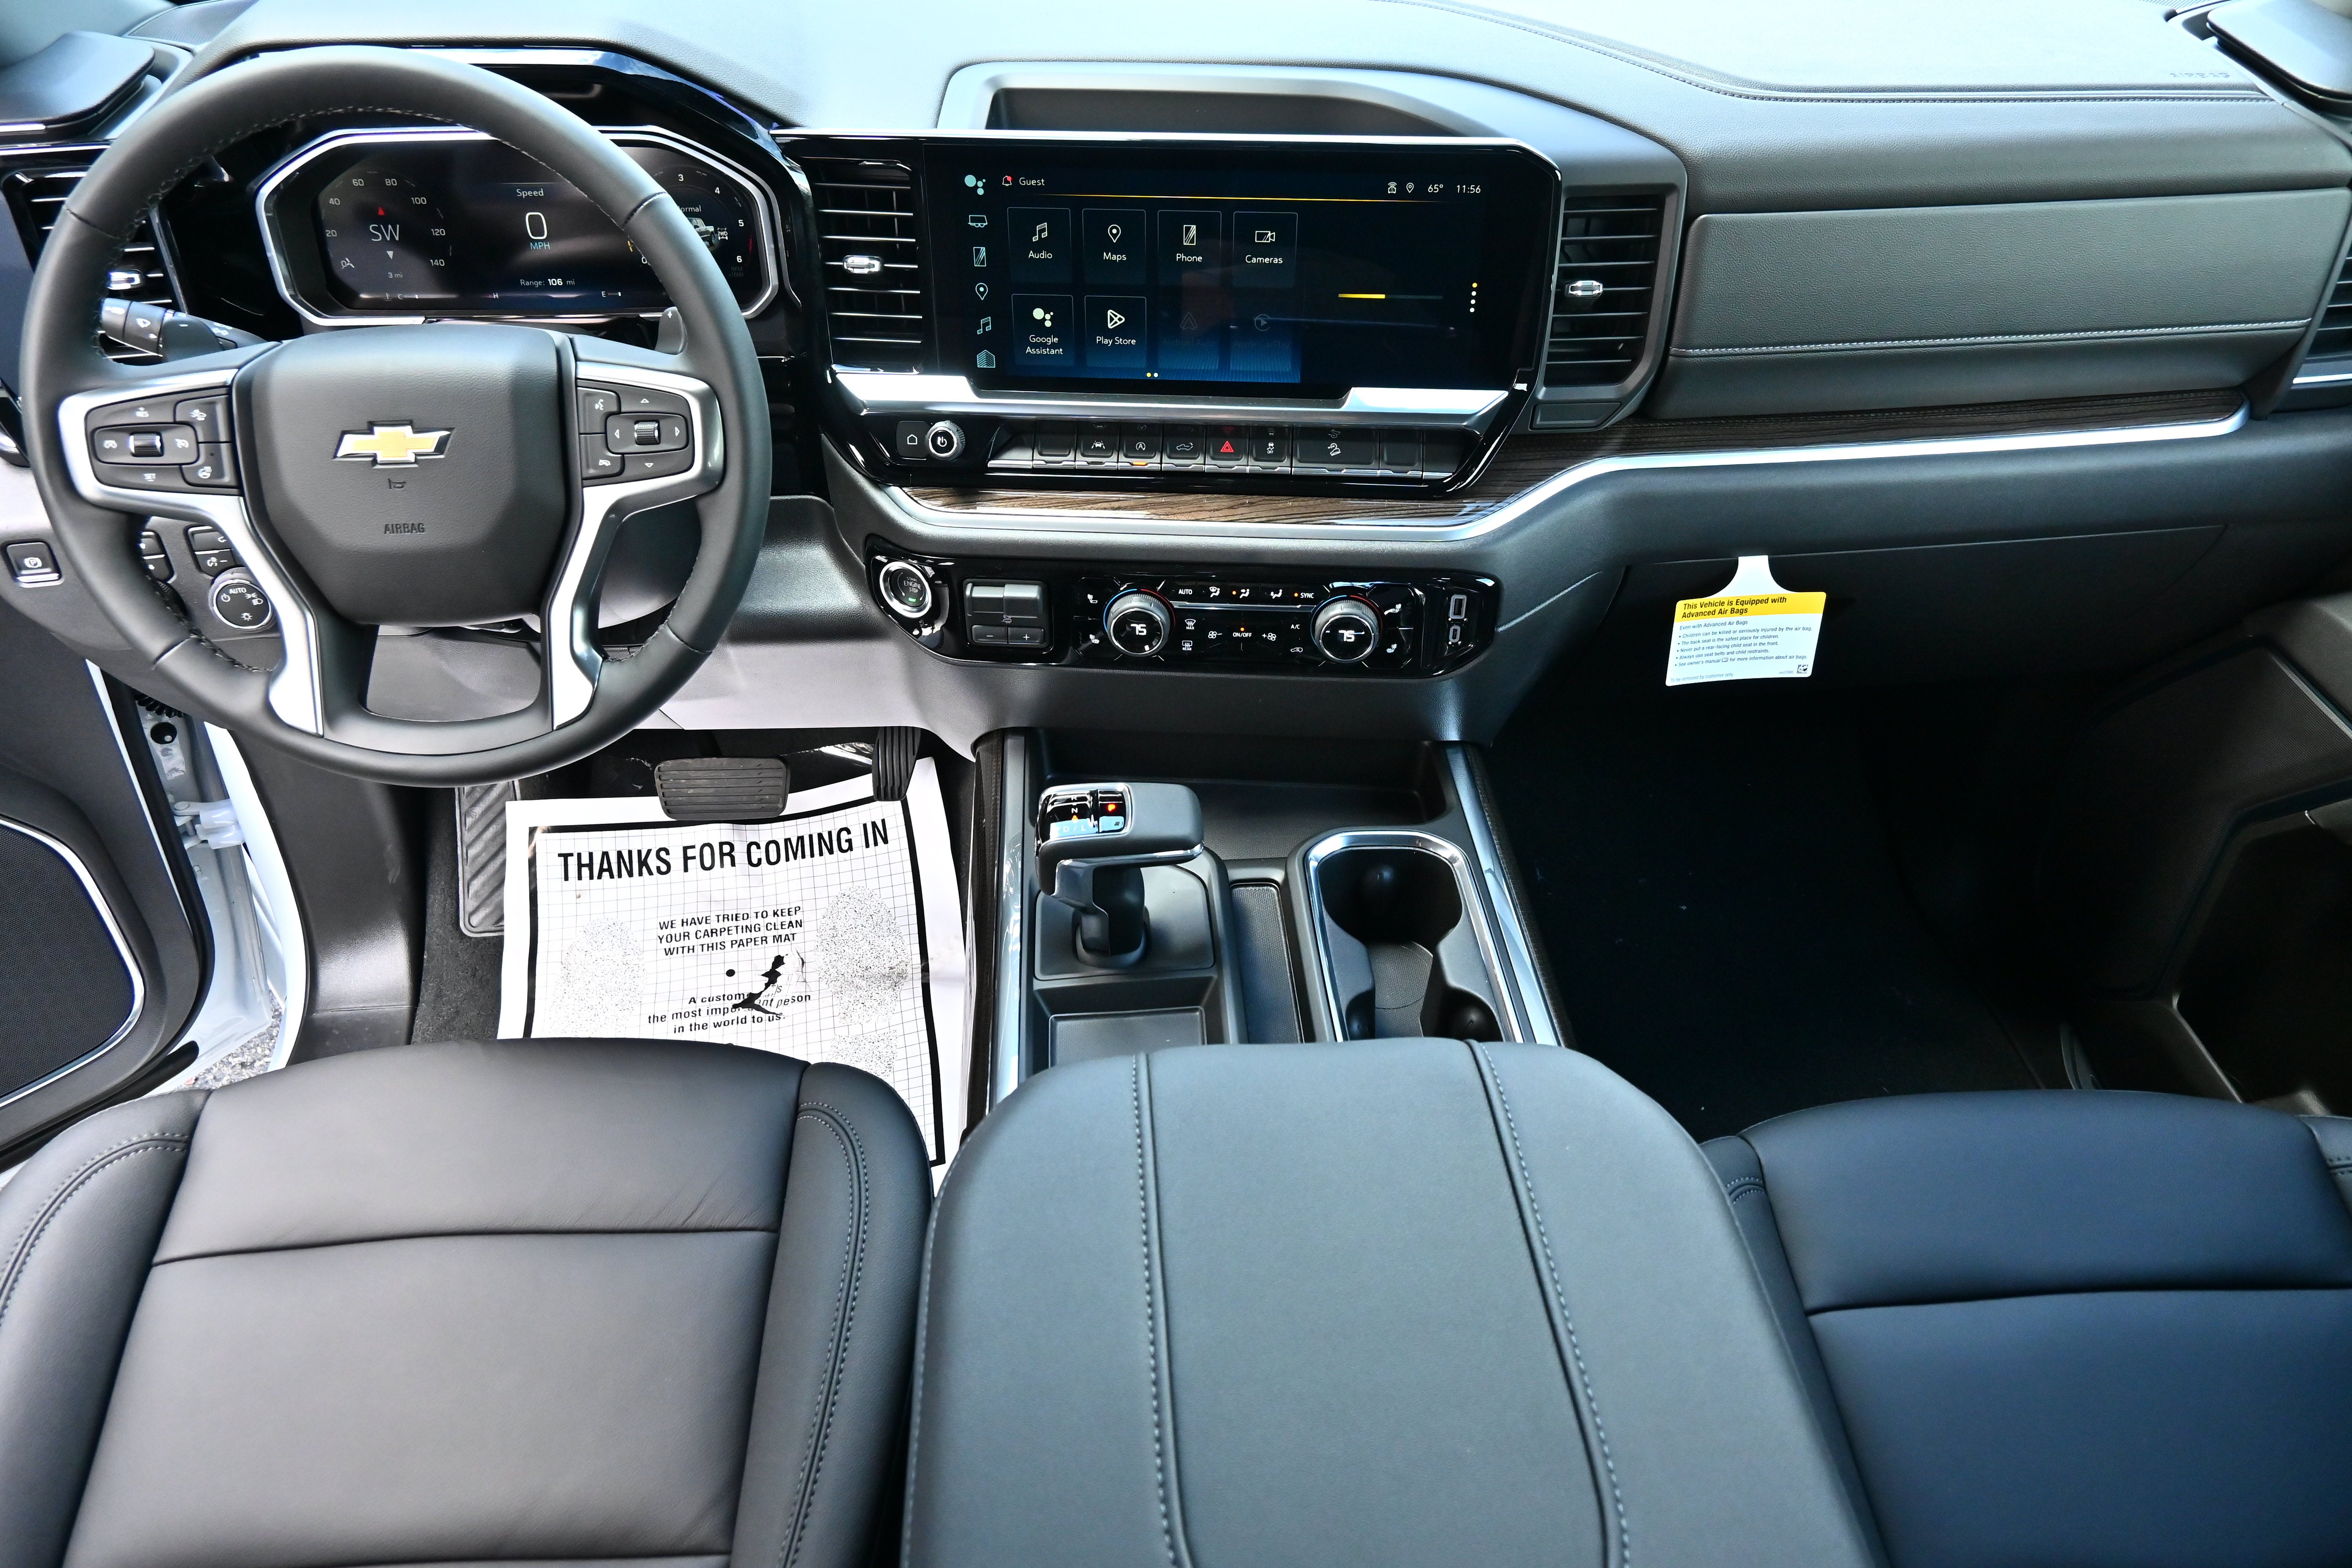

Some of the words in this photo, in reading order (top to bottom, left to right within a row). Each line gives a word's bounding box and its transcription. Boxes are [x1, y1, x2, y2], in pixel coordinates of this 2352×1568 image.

[385, 178, 397, 186] 80
[678, 174, 684, 182] 3
[1019, 177, 1045, 186] Guest
[516, 188, 544, 197] Speed
[1456, 185, 1481, 194] 11:56
[411, 197, 427, 205] 100
[525, 212, 548, 240] 0
[370, 224, 400, 241] SW
[530, 242, 550, 250] MPH
[1028, 250, 1053, 259] Audio
[1103, 252, 1127, 262] Maps
[1176, 254, 1203, 263] Phone
[1245, 255, 1283, 264] Cameras
[520, 279, 545, 287] Range:
[1029, 335, 1059, 345] Google
[1096, 336, 1113, 346] Play
[1114, 337, 1136, 345] Store
[1026, 346, 1063, 355] Assistant
[384, 522, 426, 535] AIRBAG
[904, 580, 921, 590] ENGINE
[1700, 600, 1725, 608] Vehicle
[1735, 597, 1769, 607] Equipped
[1682, 609, 1716, 618] Advanced
[1130, 623, 1147, 635] 75
[1339, 630, 1355, 642] 75
[1108, 803, 1116, 811] P
[558, 847, 671, 882] THANKS
[682, 841, 736, 872] FOR
[746, 827, 854, 868] COMING
[863, 818, 889, 849] IN
[659, 920, 676, 930] WE
[681, 915, 711, 927] HAVE
[715, 912, 749, 923] TRIED
[754, 910, 768, 920] TO
[773, 906, 801, 917] KEEP
[657, 931, 691, 944] YOUR
[695, 923, 761, 940] CARPETING
[765, 919, 803, 931] CLEAN
[664, 945, 695, 956] WITH
[699, 941, 726, 953] THIS
[730, 936, 768, 949] PAPER
[773, 933, 797, 943] MAT
[648, 1014, 667, 1024] the
[672, 1007, 706, 1020] most
[674, 1025, 684, 1034] in
[690, 1021, 708, 1032] the
[713, 1015, 747, 1029] world
[751, 1015, 763, 1024] to
